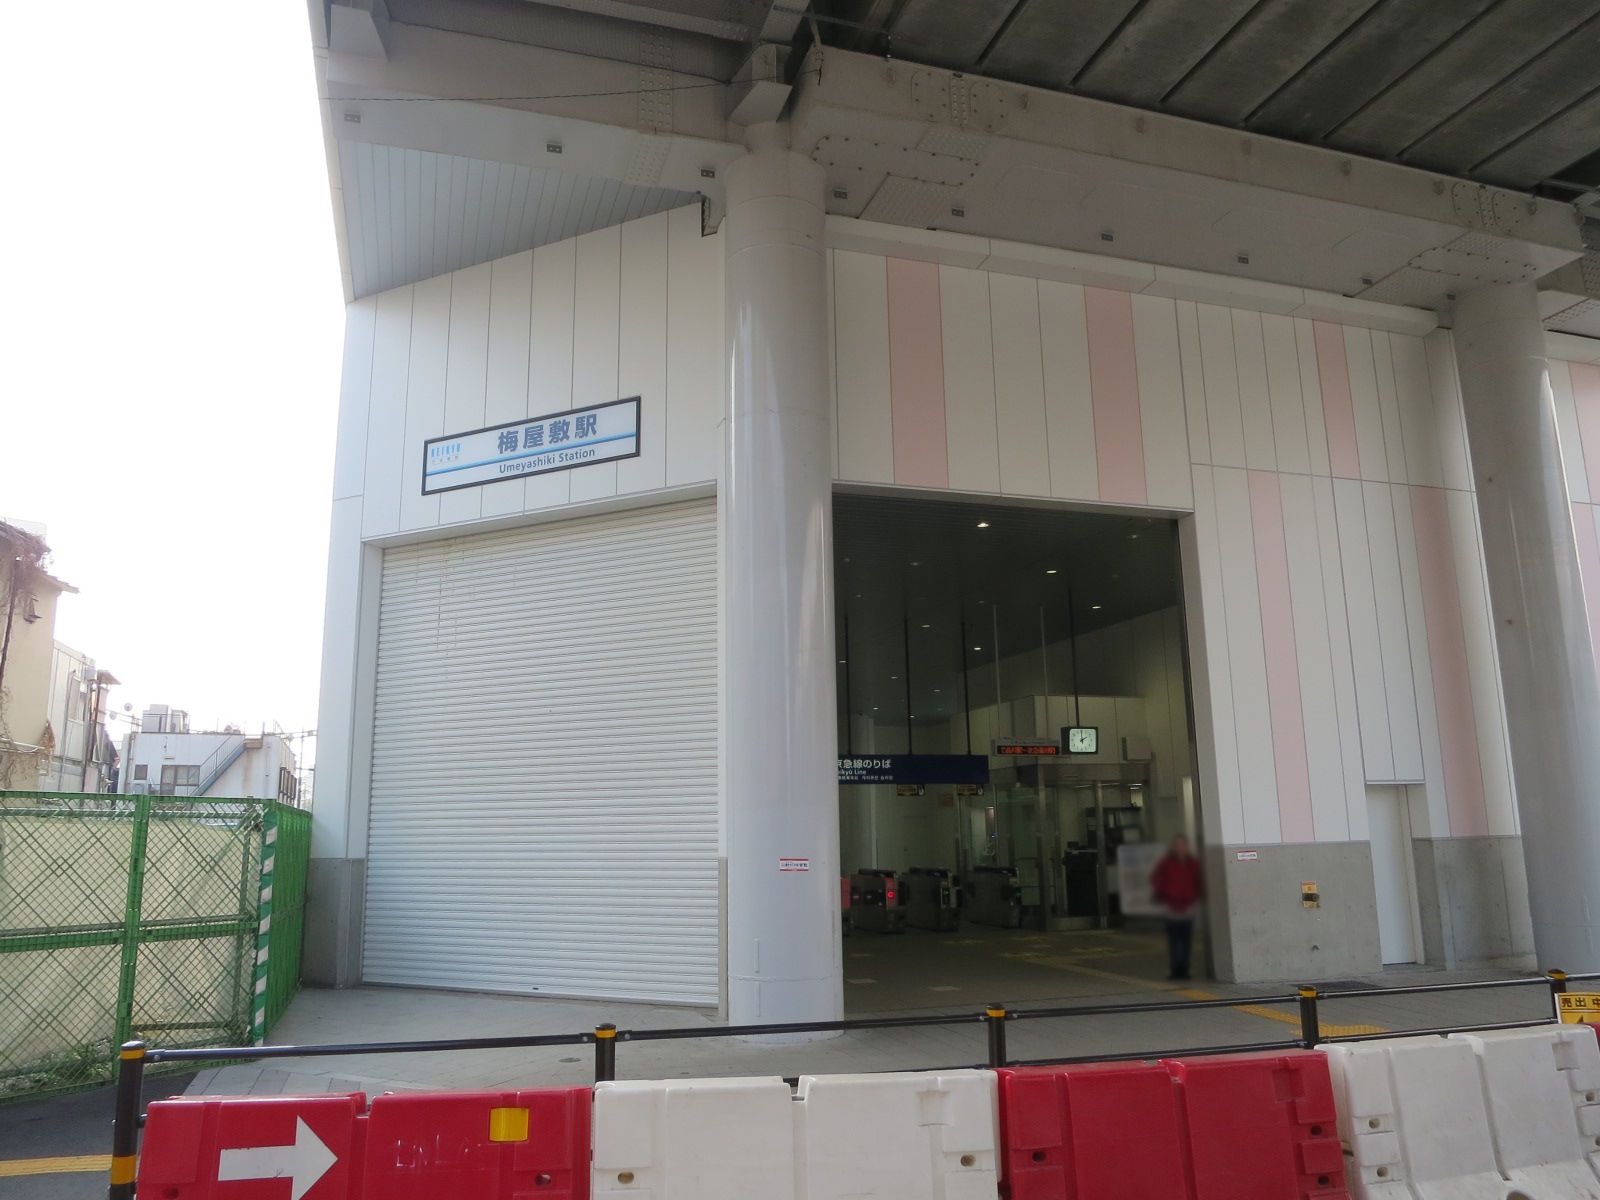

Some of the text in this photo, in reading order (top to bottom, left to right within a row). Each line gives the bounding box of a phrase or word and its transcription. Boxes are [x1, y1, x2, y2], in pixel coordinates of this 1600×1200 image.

[498, 414, 597, 454] 梅屋敷駅
[499, 447, 595, 474] Umeyashiki Station
